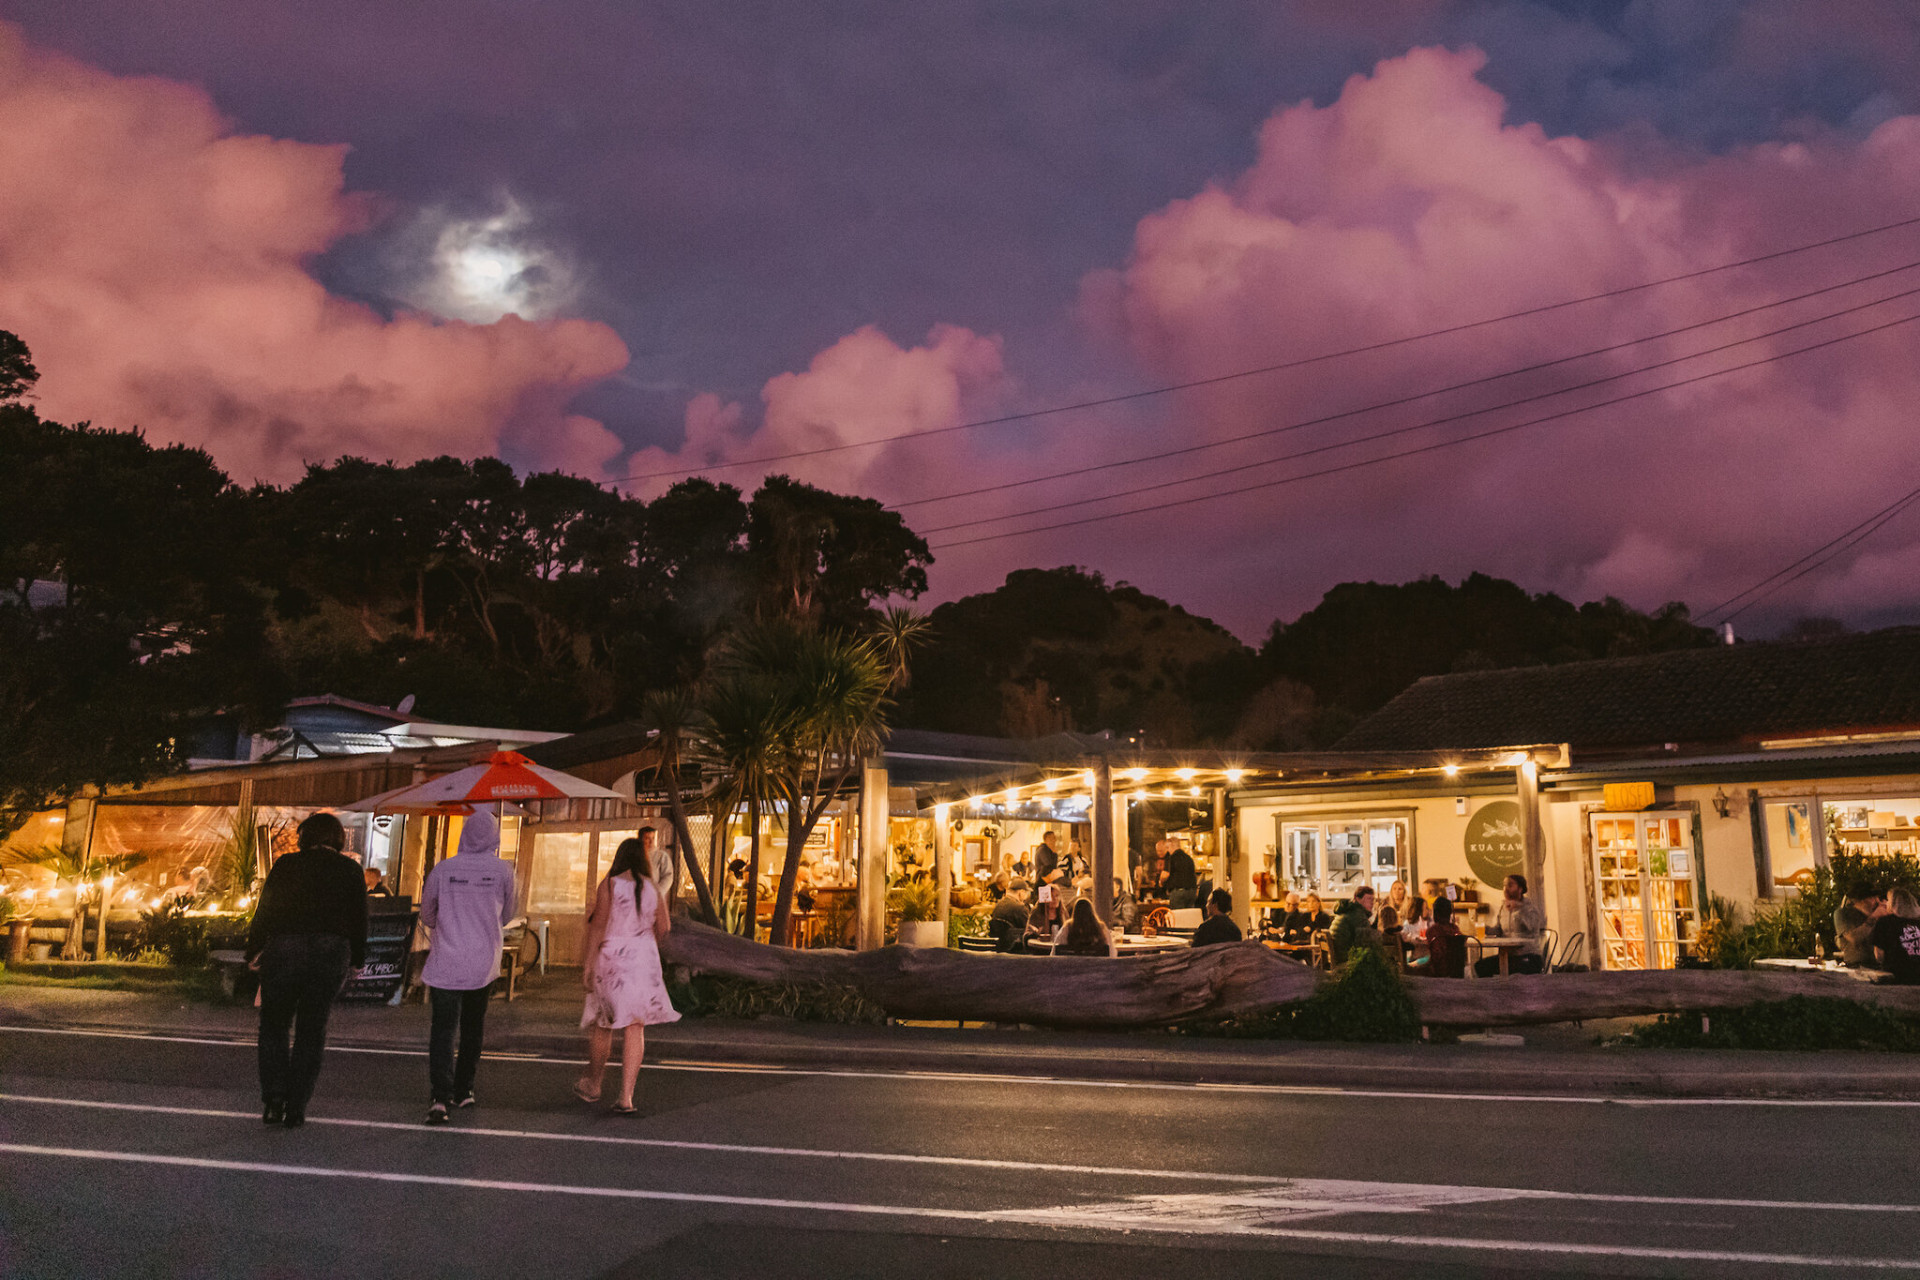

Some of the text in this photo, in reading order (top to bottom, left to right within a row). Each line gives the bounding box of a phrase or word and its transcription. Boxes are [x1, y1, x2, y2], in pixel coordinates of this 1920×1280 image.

[1605, 784, 1654, 809] CLOSED
[1470, 842, 1524, 852] KUA KAW
